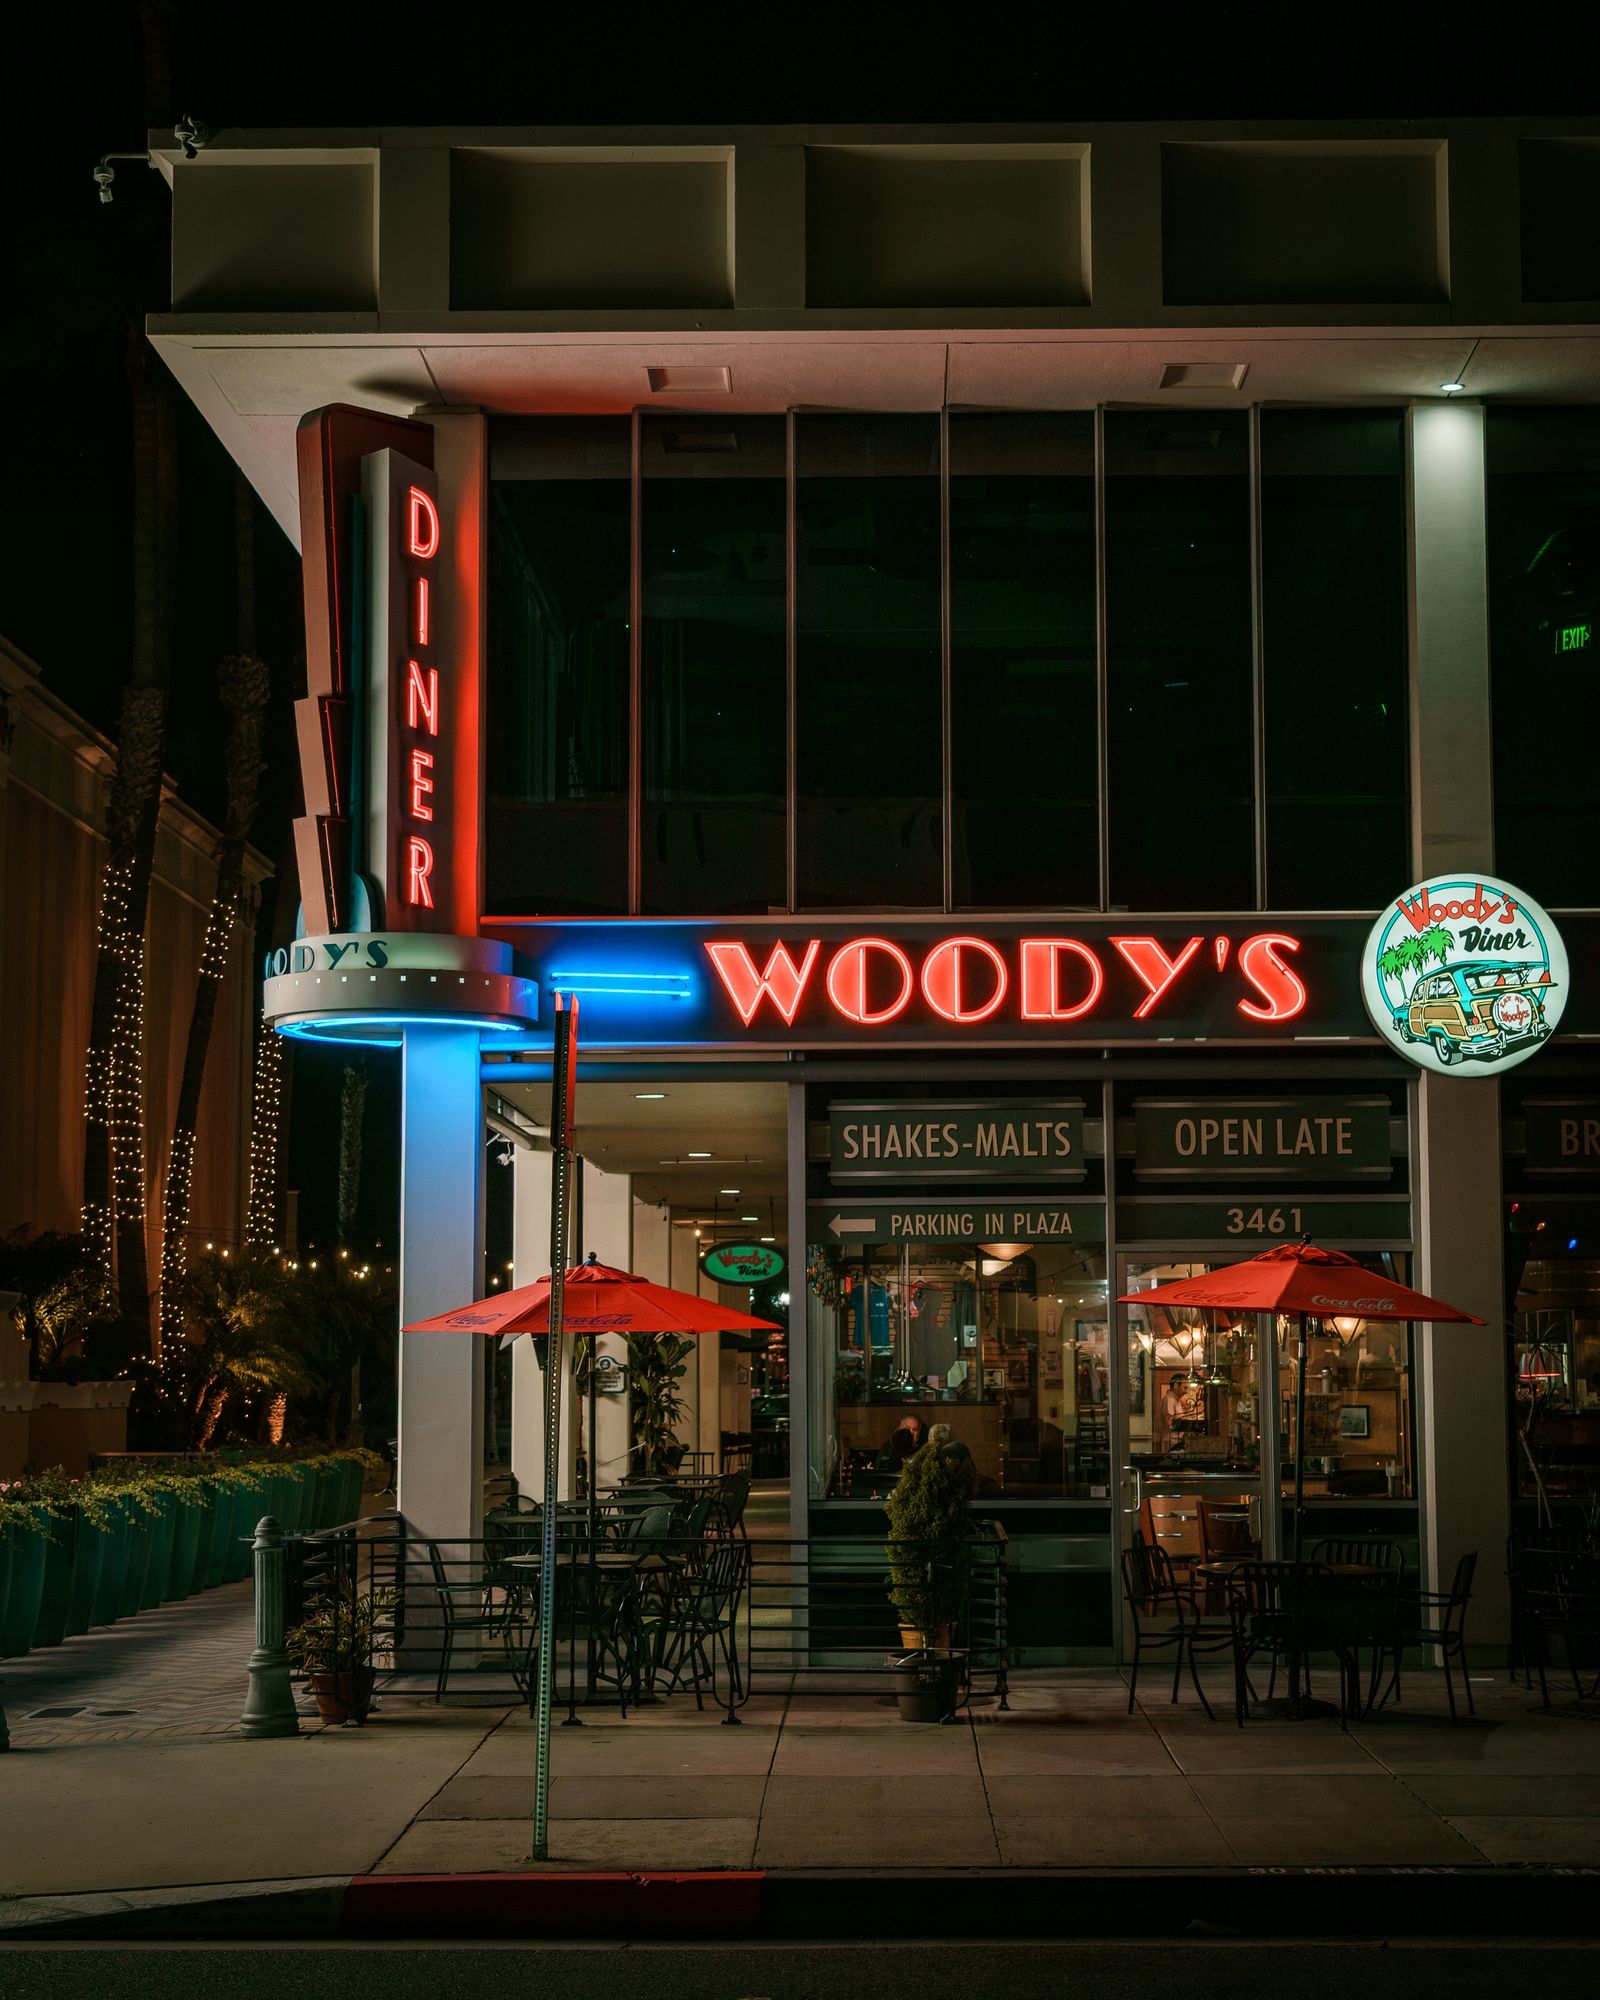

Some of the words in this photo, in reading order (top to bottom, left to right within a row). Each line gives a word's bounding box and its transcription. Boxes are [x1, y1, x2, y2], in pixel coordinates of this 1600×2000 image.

[1562, 626, 1586, 651] EXIT
[408, 485, 439, 909] DINER
[1395, 883, 1519, 933] Woody's
[1458, 925, 1531, 953] Diner
[703, 933, 1307, 1028] WOODY'S
[842, 1121, 1072, 1159] SHAKES-MALTS
[1174, 1118, 1264, 1156] OPEN
[1276, 1117, 1353, 1155] LATE
[890, 1213, 975, 1236] PARKING
[985, 1213, 1004, 1236] IN
[1013, 1212, 1073, 1235] PLAZA
[1226, 1208, 1302, 1233] 3461
[716, 1249, 774, 1268] Woody's
[736, 1264, 769, 1276] Diner
[1303, 1867, 1358, 1875] MIN
